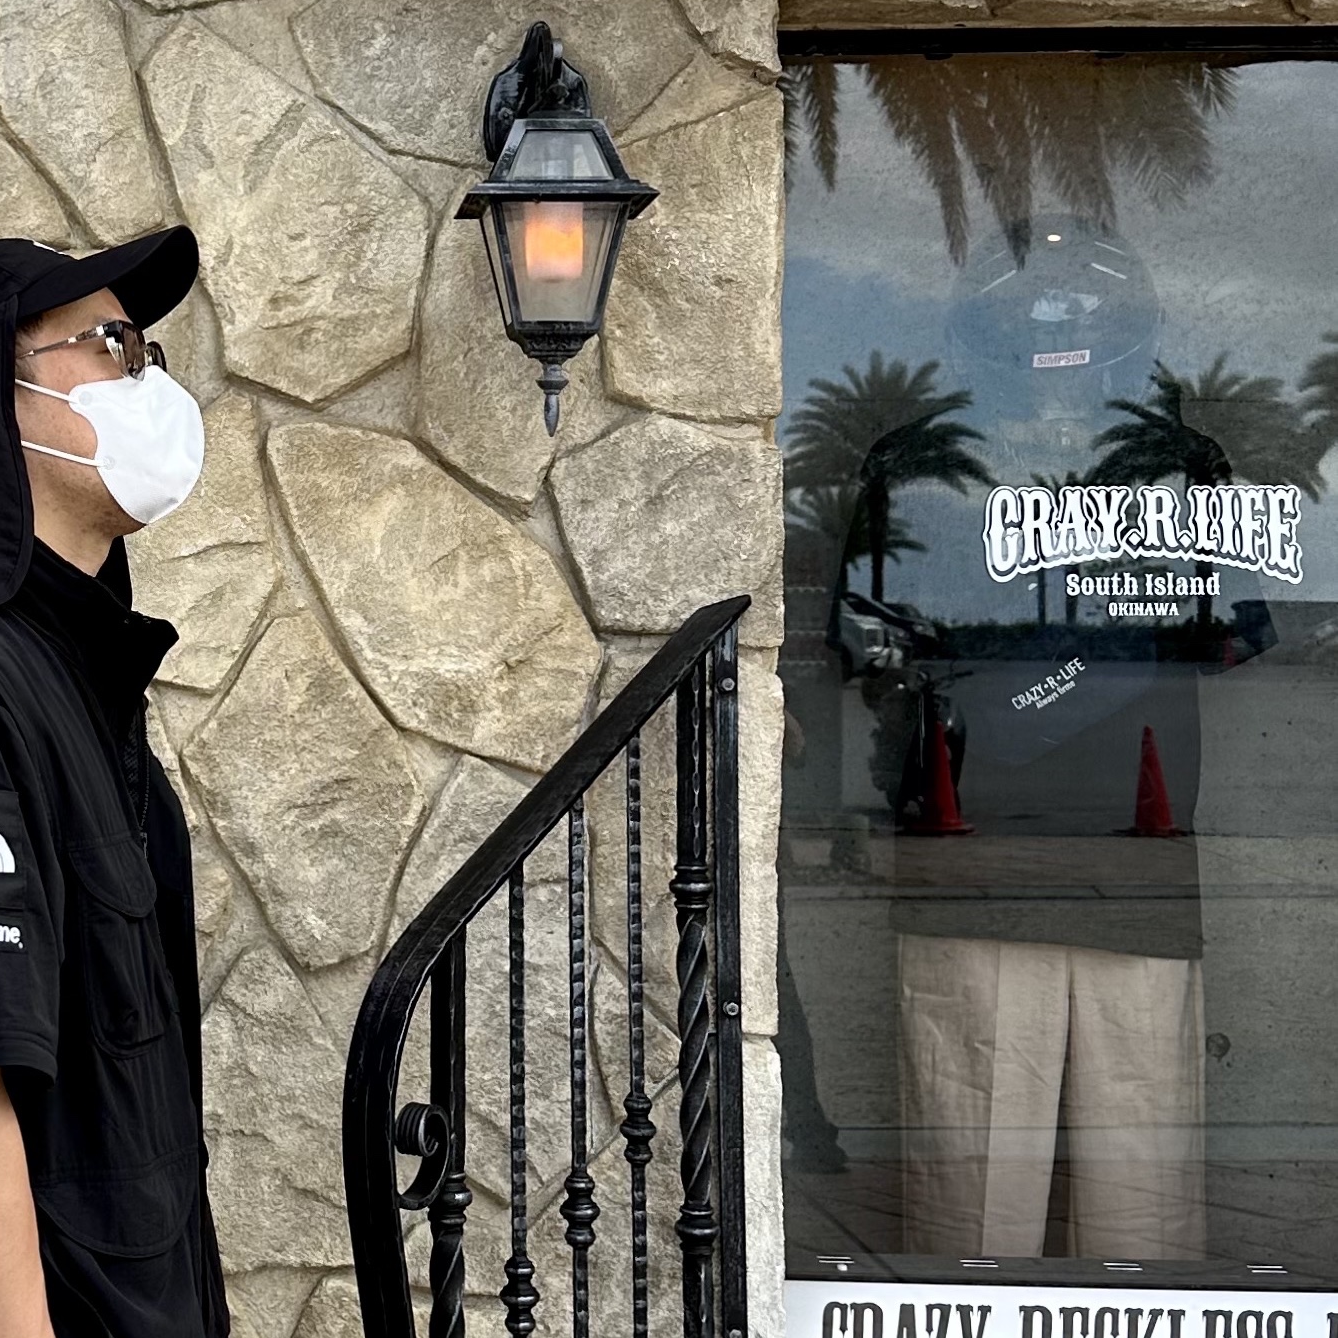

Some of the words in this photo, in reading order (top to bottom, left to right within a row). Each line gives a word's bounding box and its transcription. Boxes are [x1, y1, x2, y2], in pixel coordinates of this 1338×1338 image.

[1036, 351, 1087, 366] SIMPSON
[1066, 572, 1139, 597] South
[1145, 572, 1221, 596] Island
[1108, 602, 1179, 616] OKINAWA
[1035, 691, 1059, 709] Always
